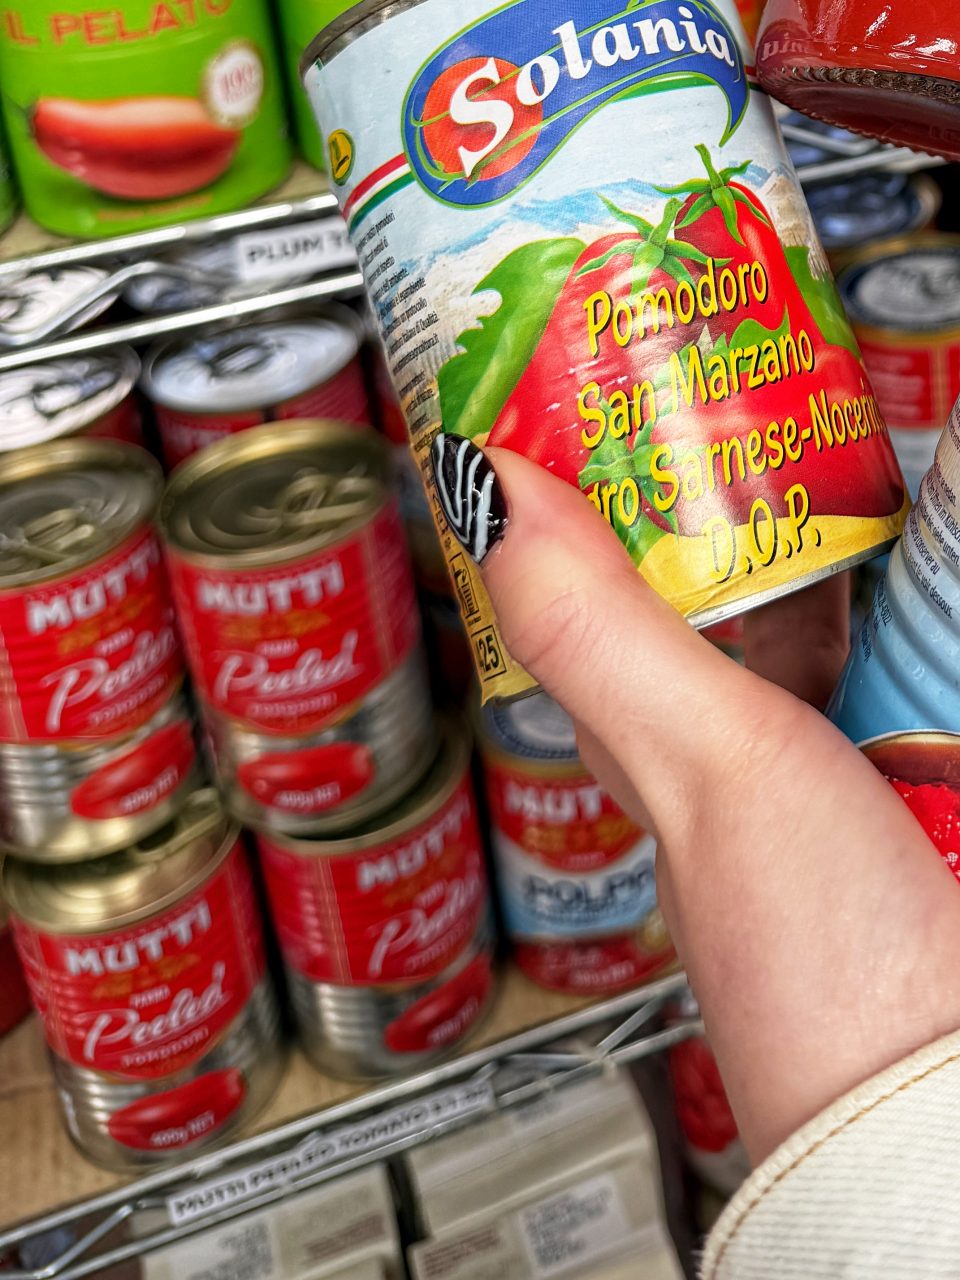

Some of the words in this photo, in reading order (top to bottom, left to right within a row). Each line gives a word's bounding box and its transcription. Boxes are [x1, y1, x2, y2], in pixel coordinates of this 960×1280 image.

[449, 5, 735, 178] Solania
[583, 258, 768, 358] Pomodoro
[577, 378, 657, 450] San
[669, 329, 815, 412] Marzano
[704, 483, 822, 583] D.O.P.
[915, 536, 935, 565] conserver
[930, 561, 941, 576] au
[942, 541, 960, 568] unten.
[27, 535, 162, 635] MUTTI
[196, 559, 345, 618] MUTTI
[929, 585, 953, 620] dessous.
[64, 900, 212, 977] MUTTI
[74, 960, 231, 1062] Peeled
